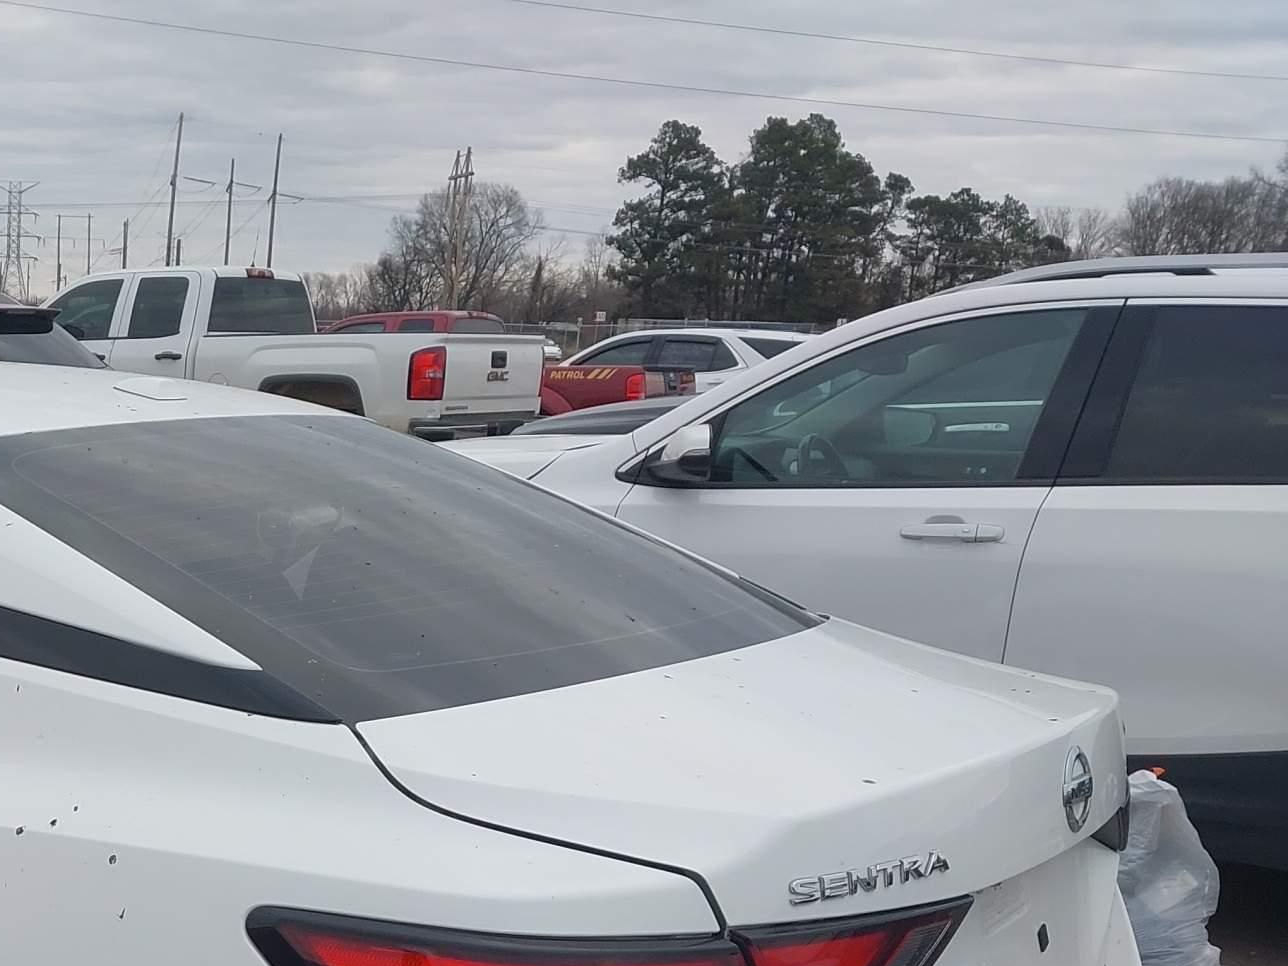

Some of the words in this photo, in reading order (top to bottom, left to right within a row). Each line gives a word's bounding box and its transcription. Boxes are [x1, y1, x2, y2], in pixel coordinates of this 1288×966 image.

[487, 370, 509, 382] GMC
[550, 369, 585, 379] PATROL
[789, 849, 950, 906] SENTRA
